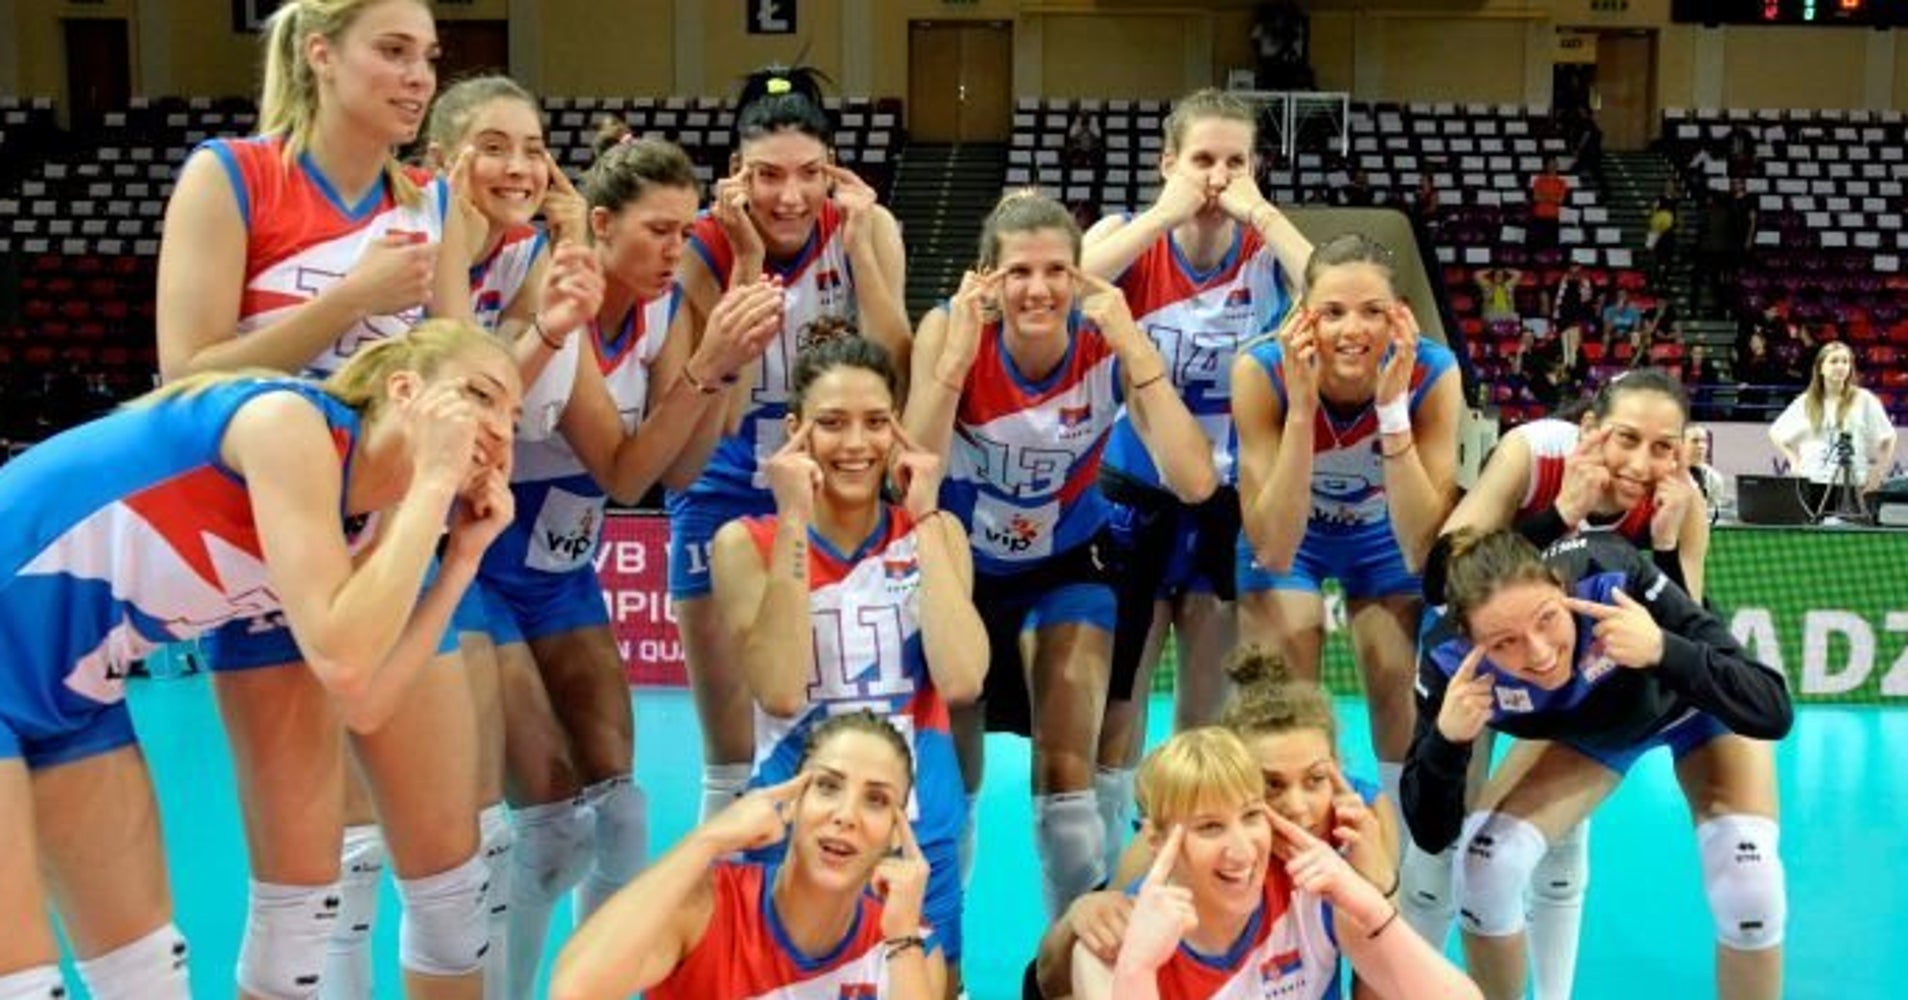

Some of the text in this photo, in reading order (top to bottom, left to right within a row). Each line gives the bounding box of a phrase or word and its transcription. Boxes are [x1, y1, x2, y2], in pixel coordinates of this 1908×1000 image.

[973, 432, 1076, 498] 13
[547, 530, 591, 560] vip
[985, 527, 1032, 552] vip
[639, 640, 686, 662] QU
[808, 603, 914, 703] 11
